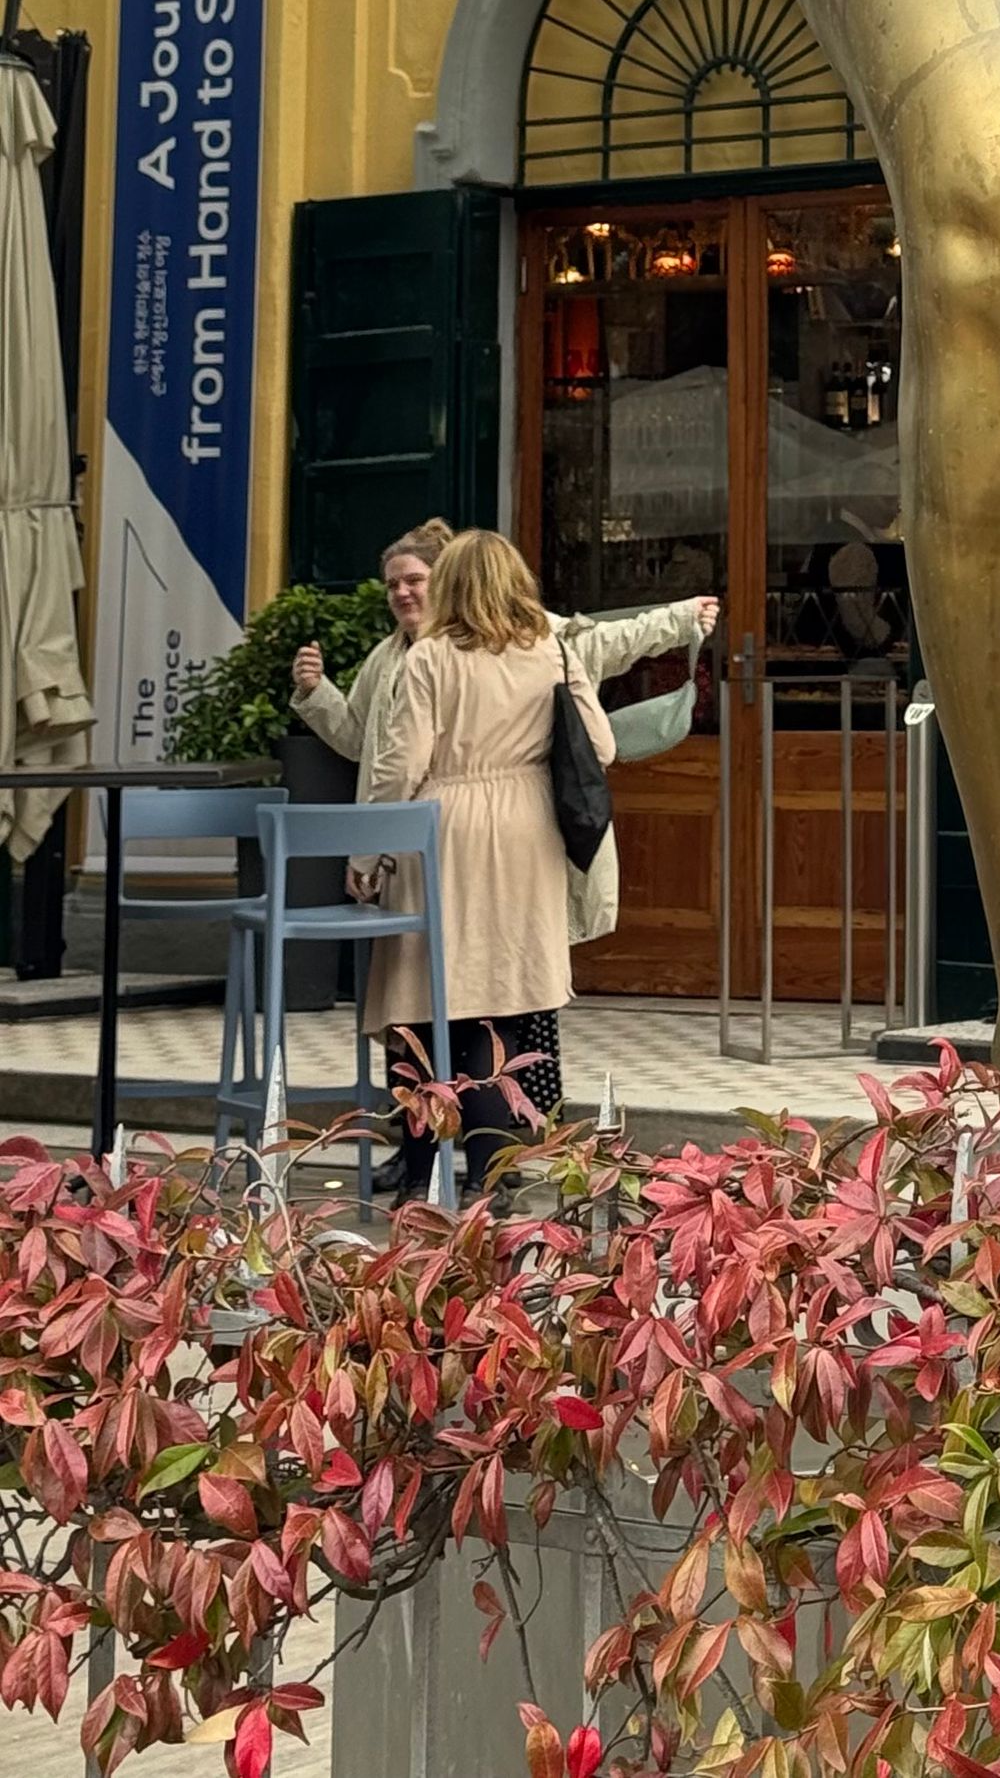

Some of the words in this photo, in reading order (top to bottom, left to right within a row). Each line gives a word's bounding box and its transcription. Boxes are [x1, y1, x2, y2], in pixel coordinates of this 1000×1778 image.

[197, 38, 234, 105] to
[137, 136, 177, 190] A
[186, 119, 232, 290] Hand
[181, 308, 227, 465] from
[132, 678, 156, 745] The
[157, 629, 181, 762] ssence
